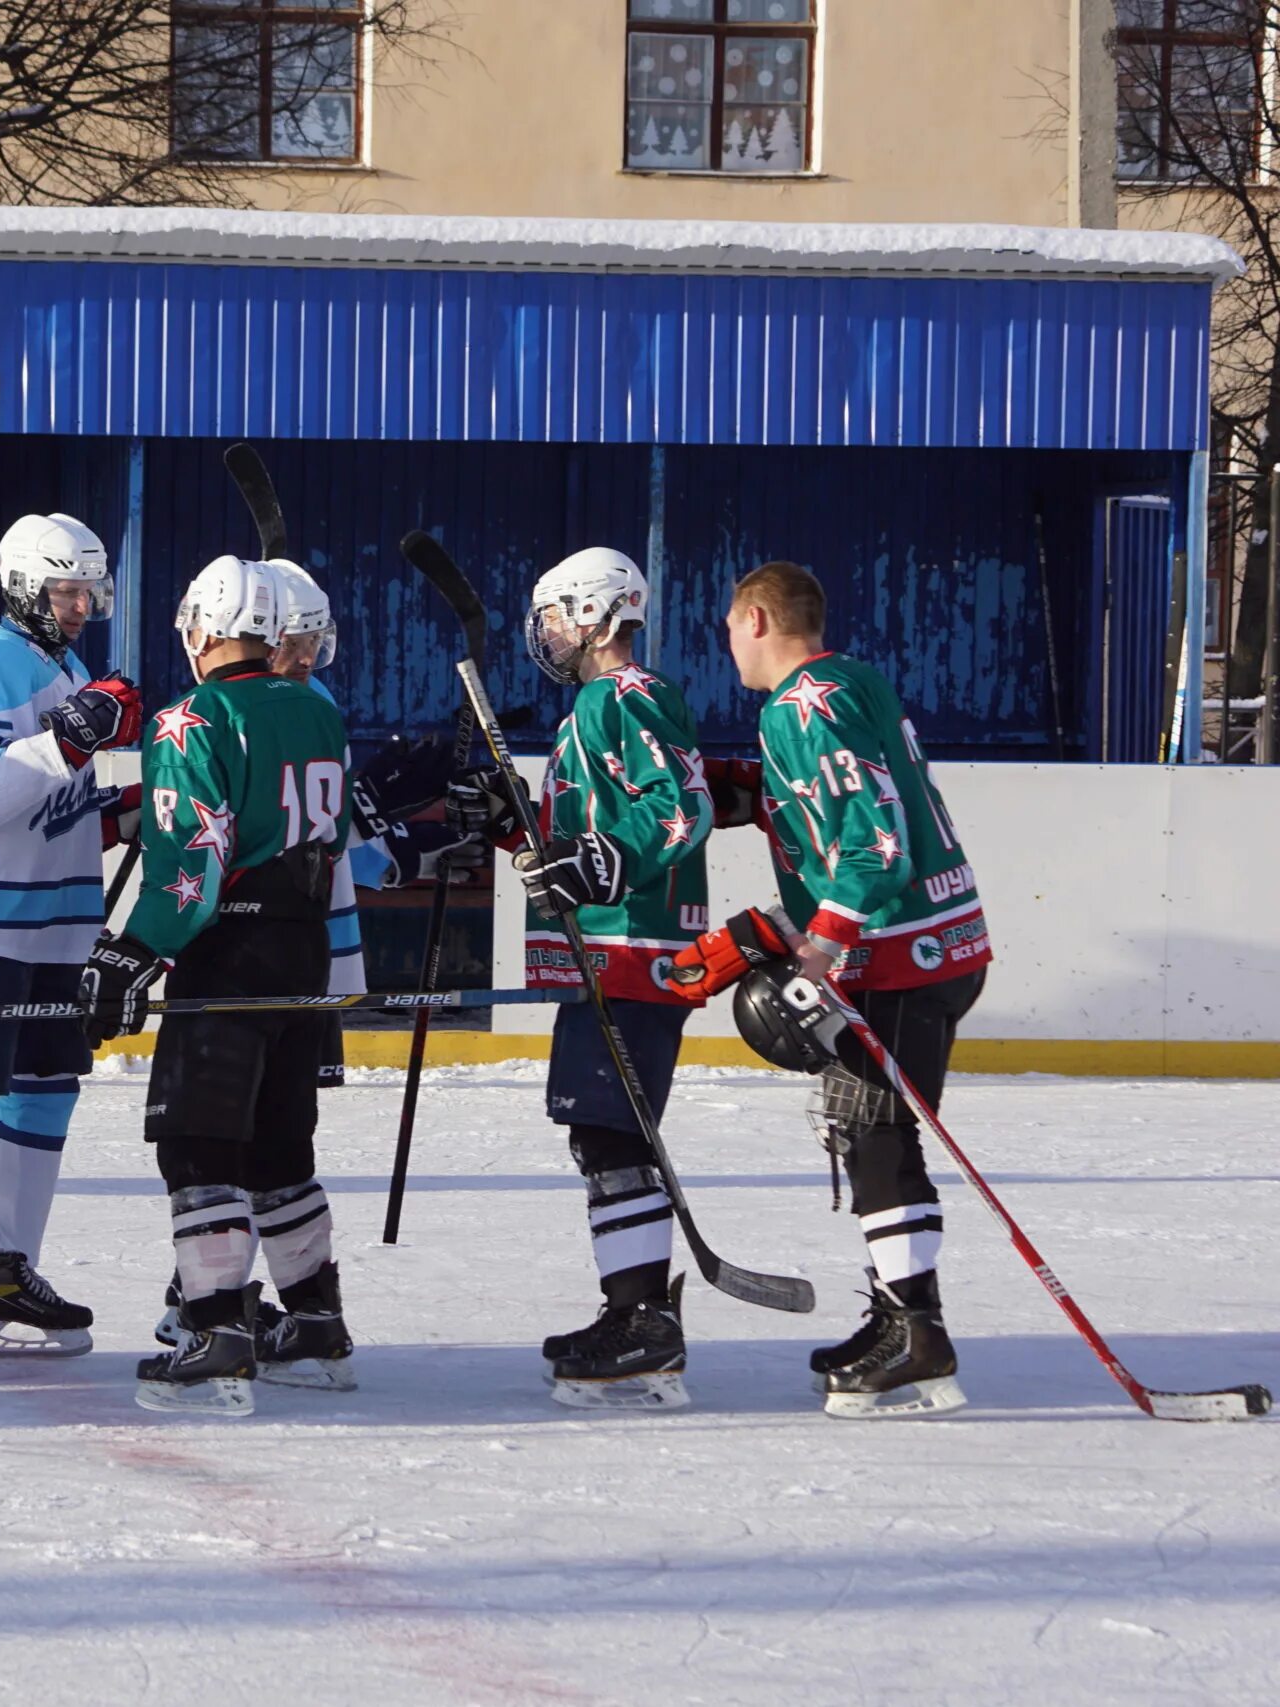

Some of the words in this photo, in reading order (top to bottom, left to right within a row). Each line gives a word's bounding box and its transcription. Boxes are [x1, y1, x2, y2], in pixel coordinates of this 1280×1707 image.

[639, 728, 666, 770] 3
[819, 749, 862, 797] 13
[153, 787, 178, 832] 18
[280, 758, 345, 850] 18
[1035, 1264, 1069, 1300] NHL
